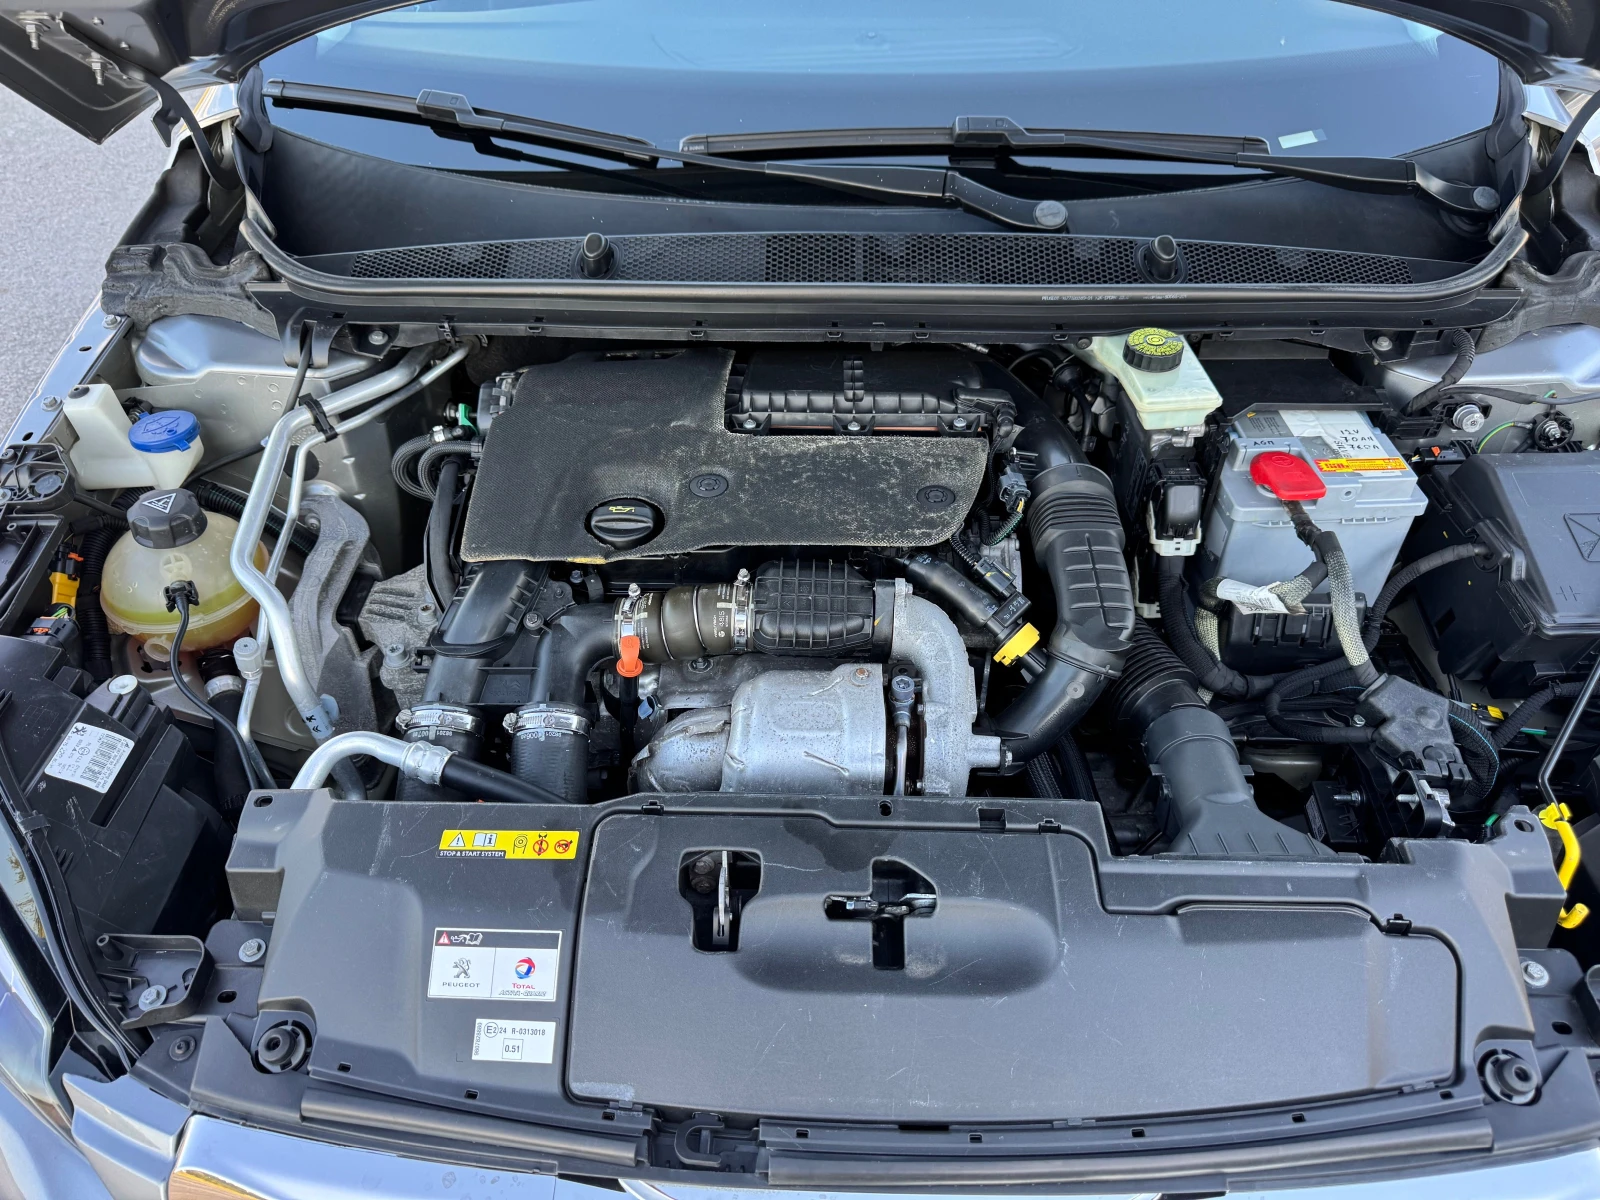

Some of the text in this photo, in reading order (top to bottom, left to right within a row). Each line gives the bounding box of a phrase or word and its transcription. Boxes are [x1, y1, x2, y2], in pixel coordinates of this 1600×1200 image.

[499, 1026, 507, 1034] 24
[511, 1027, 546, 1036] R-0313018
[504, 1044, 520, 1053] 0.51
